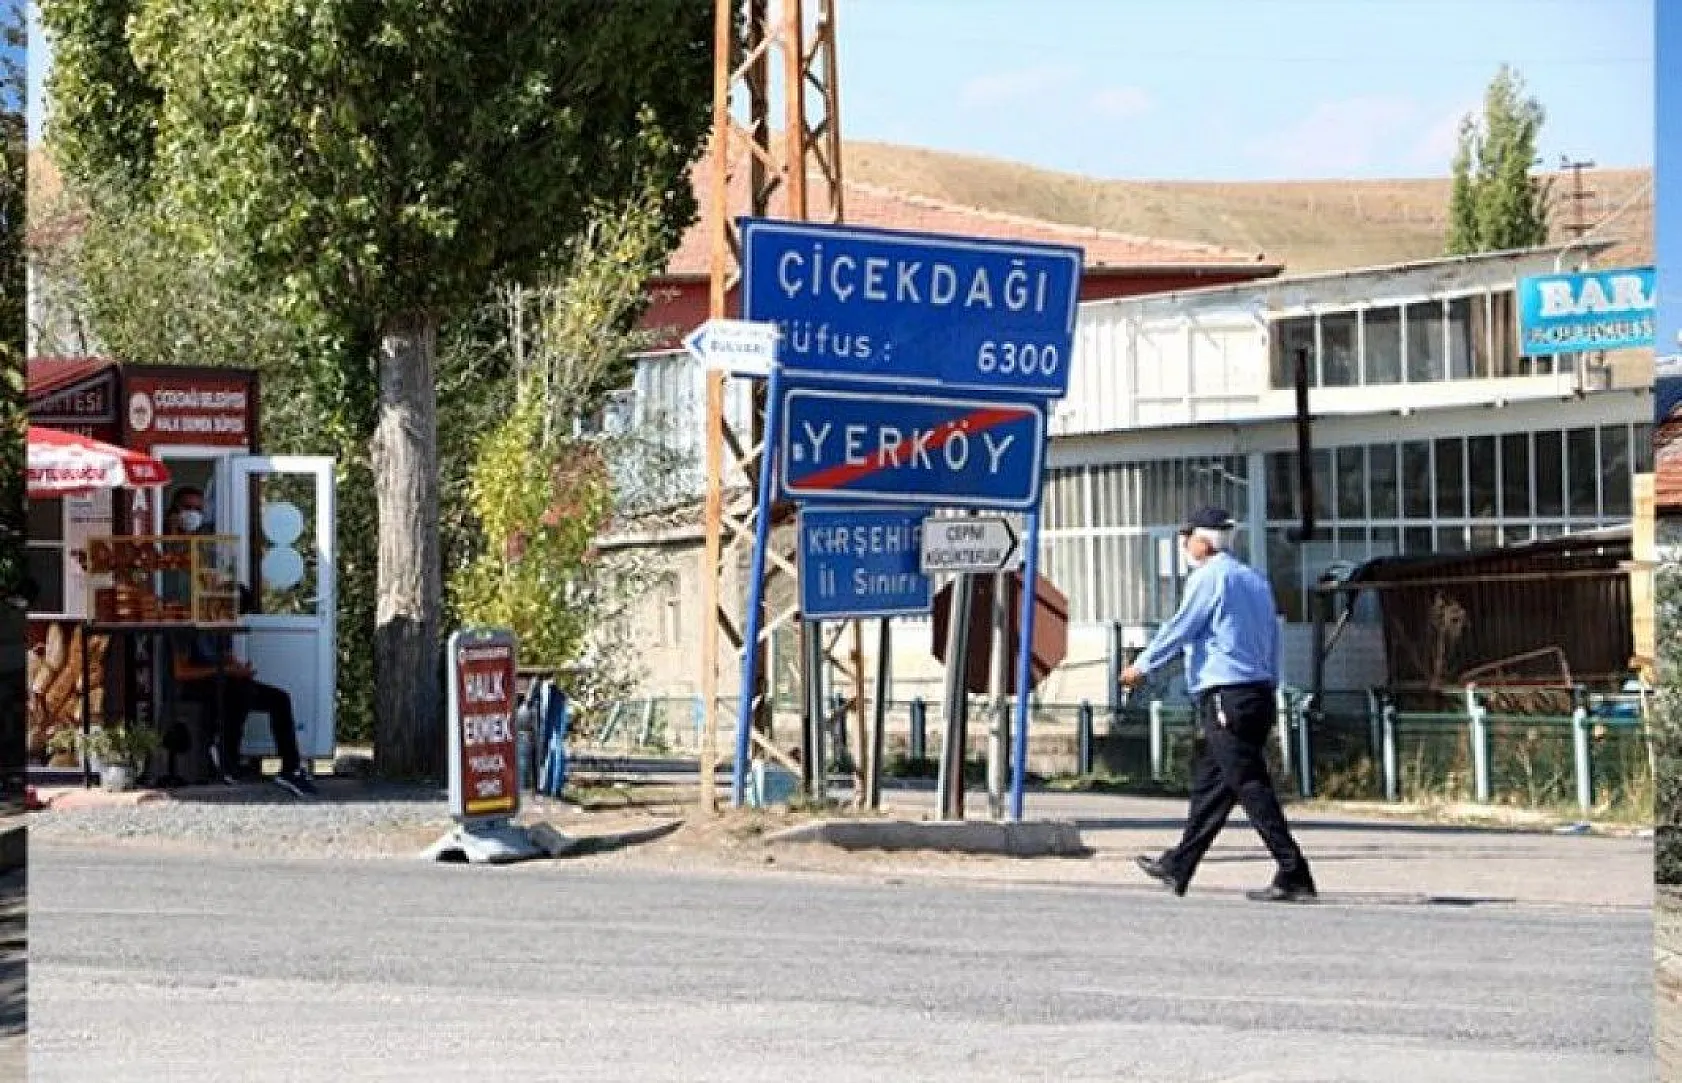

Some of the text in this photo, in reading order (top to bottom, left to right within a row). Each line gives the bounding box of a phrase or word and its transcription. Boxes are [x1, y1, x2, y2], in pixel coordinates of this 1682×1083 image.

[778, 243, 1049, 312] ÇİÇEKDAĞI
[977, 340, 1060, 376] 6300
[803, 419, 1015, 474] YERKÖY
